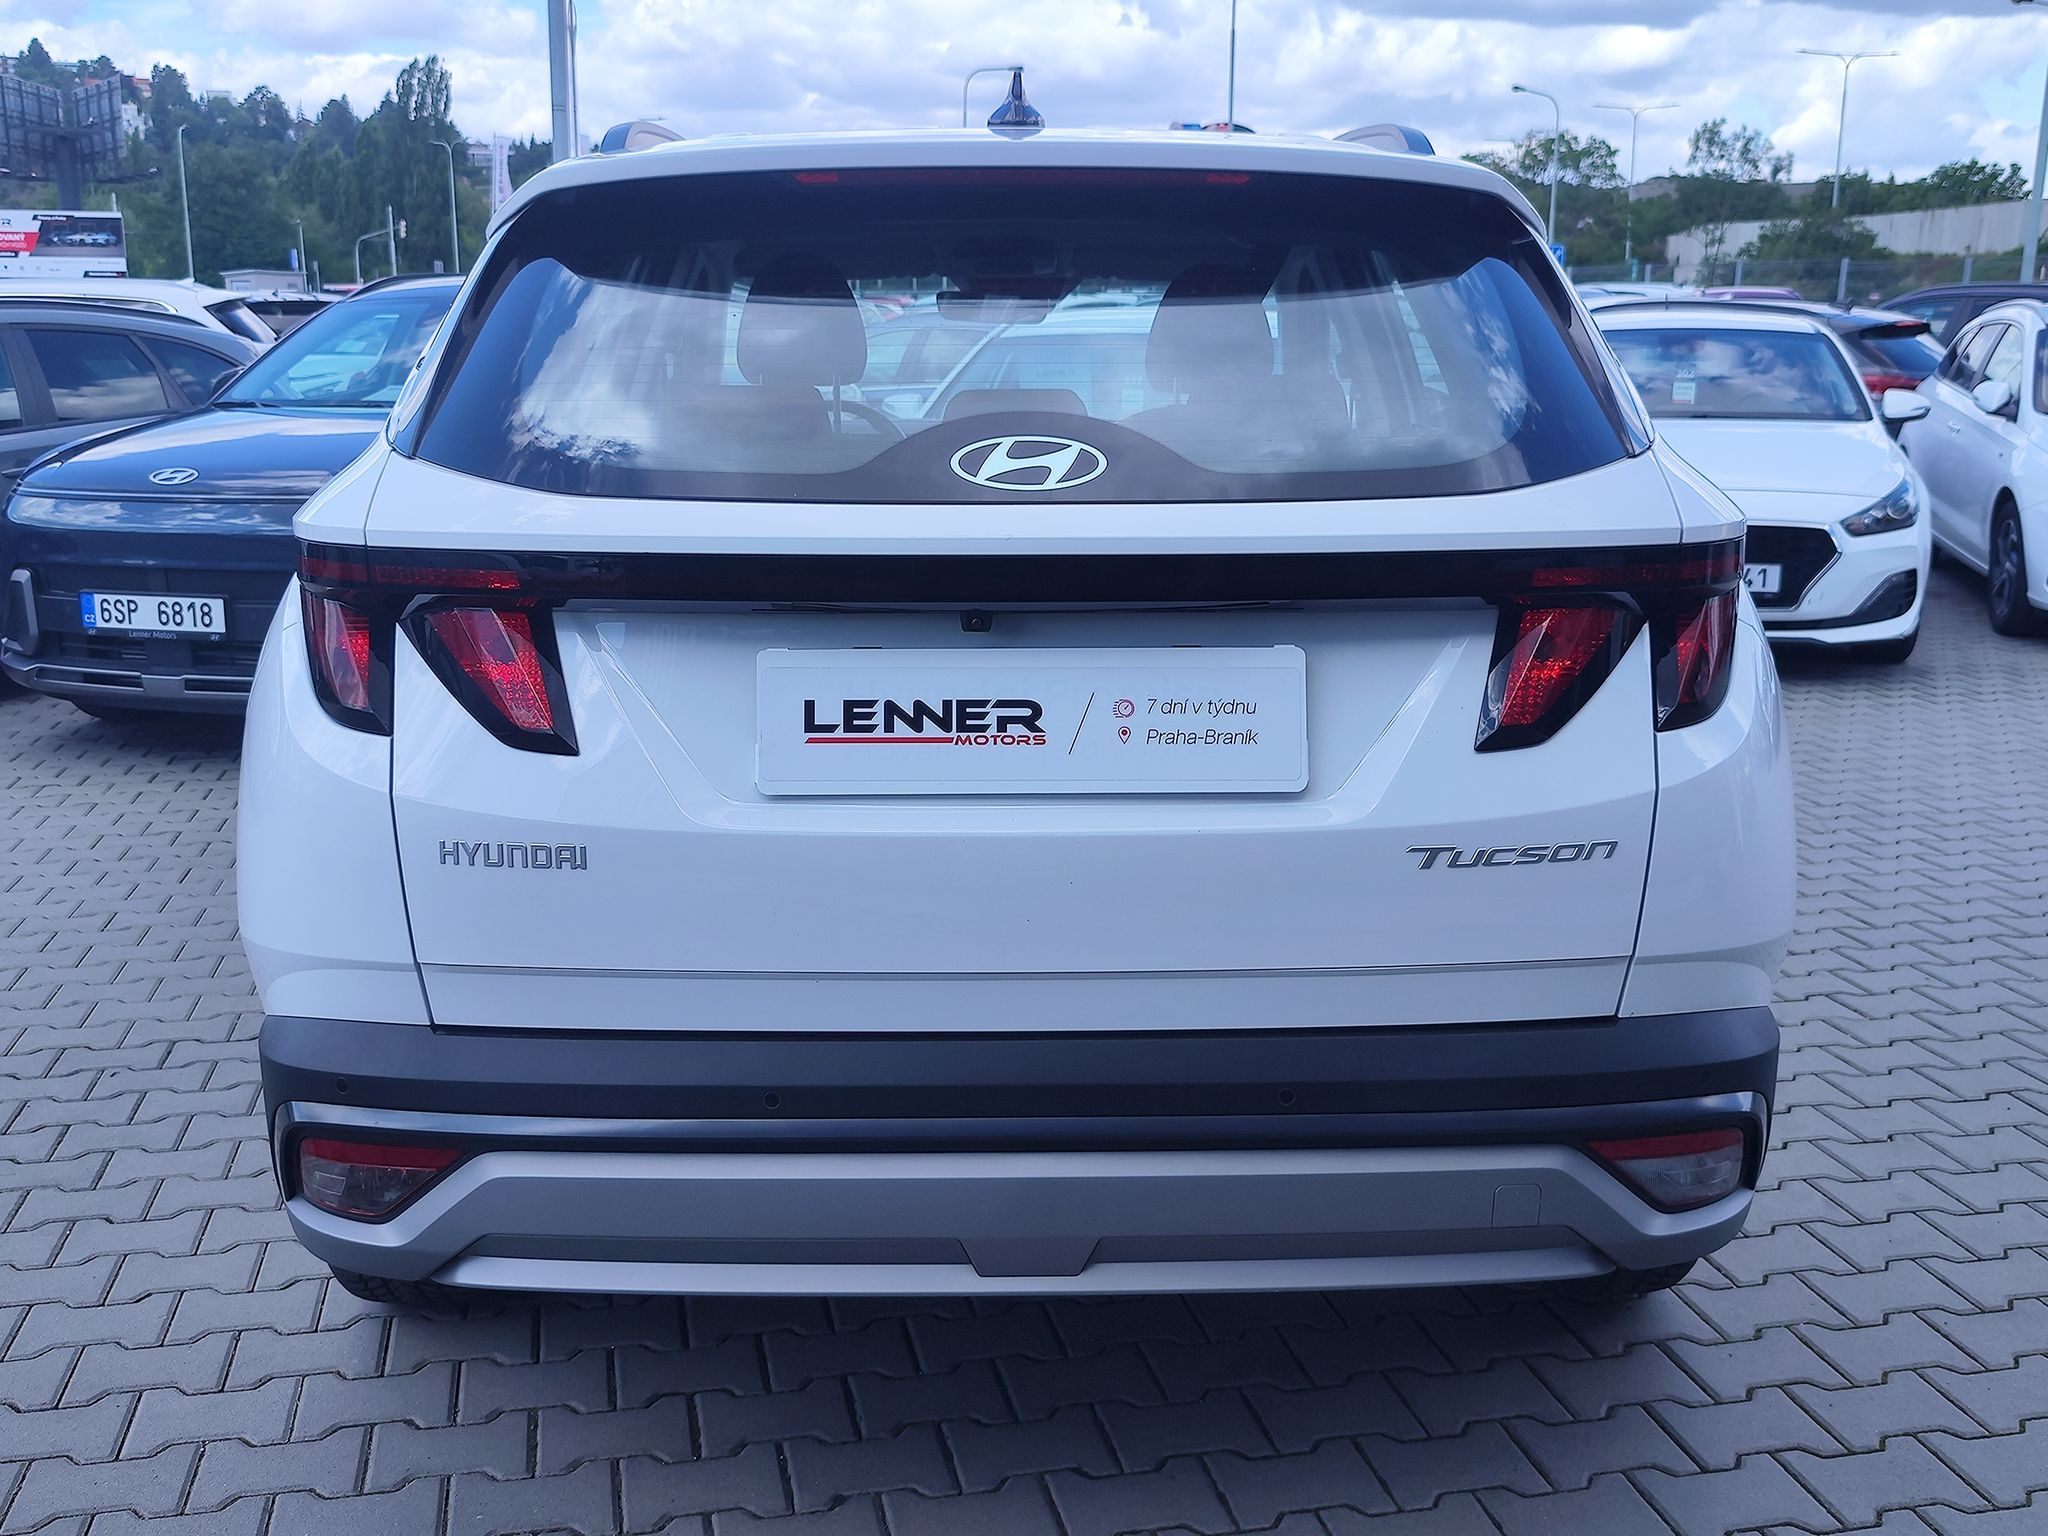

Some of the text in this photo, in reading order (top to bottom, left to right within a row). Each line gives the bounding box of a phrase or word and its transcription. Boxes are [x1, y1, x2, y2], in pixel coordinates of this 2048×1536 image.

[84, 614, 96, 623] CZ
[100, 598, 214, 628] 6SP 6818
[803, 699, 1047, 734] LENNER
[1146, 698, 1258, 718] 7 dní v týdnu
[953, 734, 1047, 746] MOTORS
[1145, 729, 1260, 745] Praha-Braník
[438, 839, 588, 871] HYUNDAI
